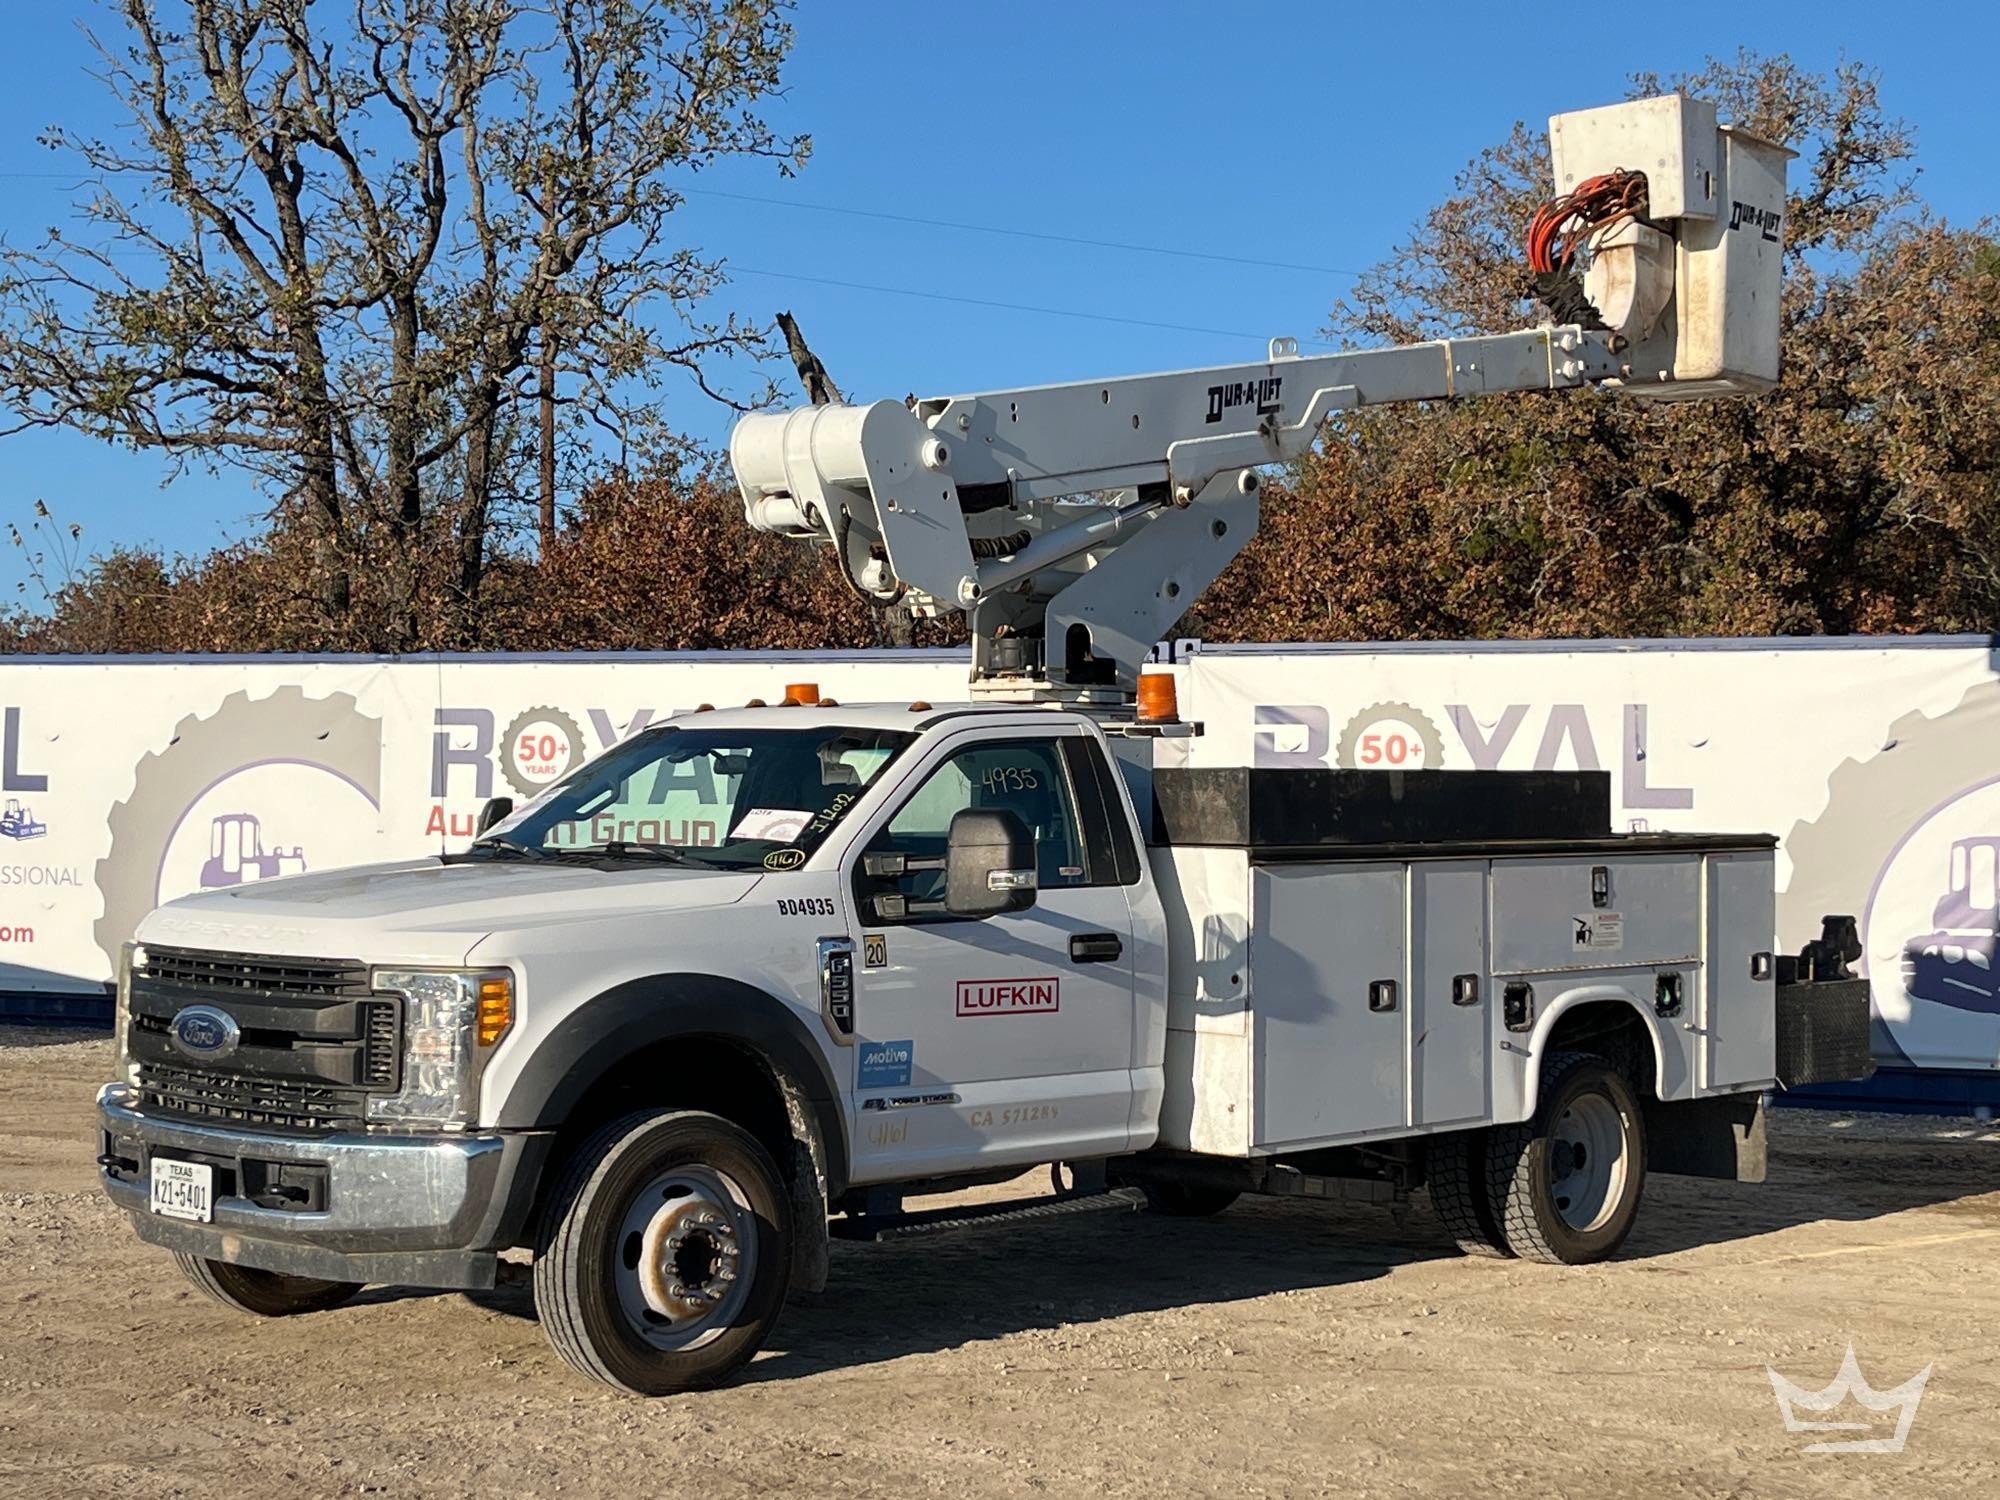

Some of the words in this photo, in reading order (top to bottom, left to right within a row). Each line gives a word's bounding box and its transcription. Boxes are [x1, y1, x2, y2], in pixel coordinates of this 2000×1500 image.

[519, 735, 568, 762] 50+
[1360, 734, 1422, 764] 50+
[525, 765, 557, 775] YEARS
[591, 812, 716, 847] Group
[867, 943, 884, 964] 20
[964, 985, 1052, 1008] LUFKIN
[183, 1018, 217, 1046] Ford
[169, 1164, 193, 1178] TEXAS
